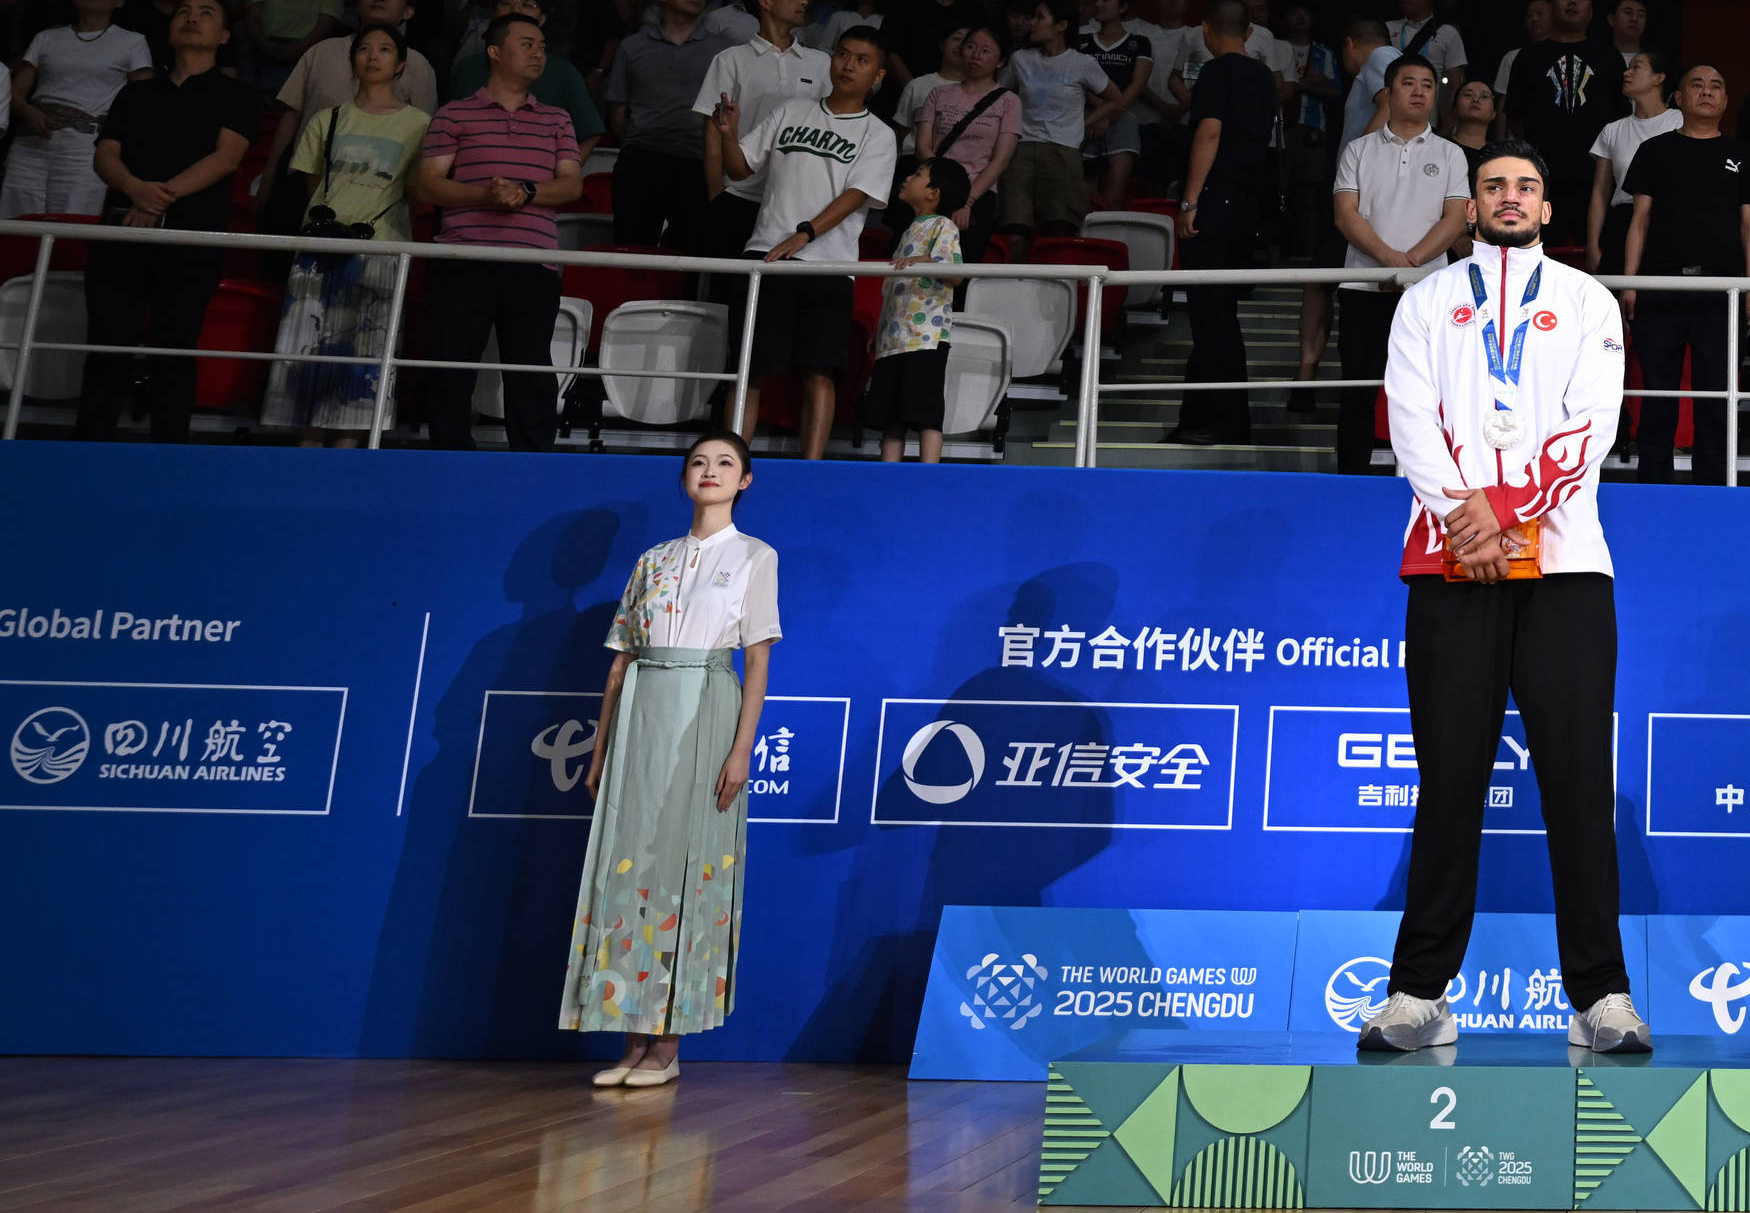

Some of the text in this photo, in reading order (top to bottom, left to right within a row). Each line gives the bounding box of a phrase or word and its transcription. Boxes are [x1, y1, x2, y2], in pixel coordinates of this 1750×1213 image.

[111, 611, 242, 643] Partner
[998, 624, 1265, 673] 官方合作伙伴
[1276, 638, 1390, 668] Official
[104, 718, 293, 764] 四川航空
[99, 764, 286, 782] SICHUAN AIRLINES
[995, 741, 1211, 790] 亚信安全
[1061, 965, 1226, 985] THE WORLD GAMES
[1053, 990, 1255, 1019] 2025 CHENGDU
[1429, 1086, 1457, 1130] 2
[1396, 1150, 1416, 1162] THE
[1499, 1151, 1515, 1161] TWG
[1396, 1162, 1434, 1173] WORLD
[1499, 1161, 1533, 1175] 2025
[1396, 1173, 1433, 1184] GAMES
[1498, 1175, 1532, 1185] CHENGDU
